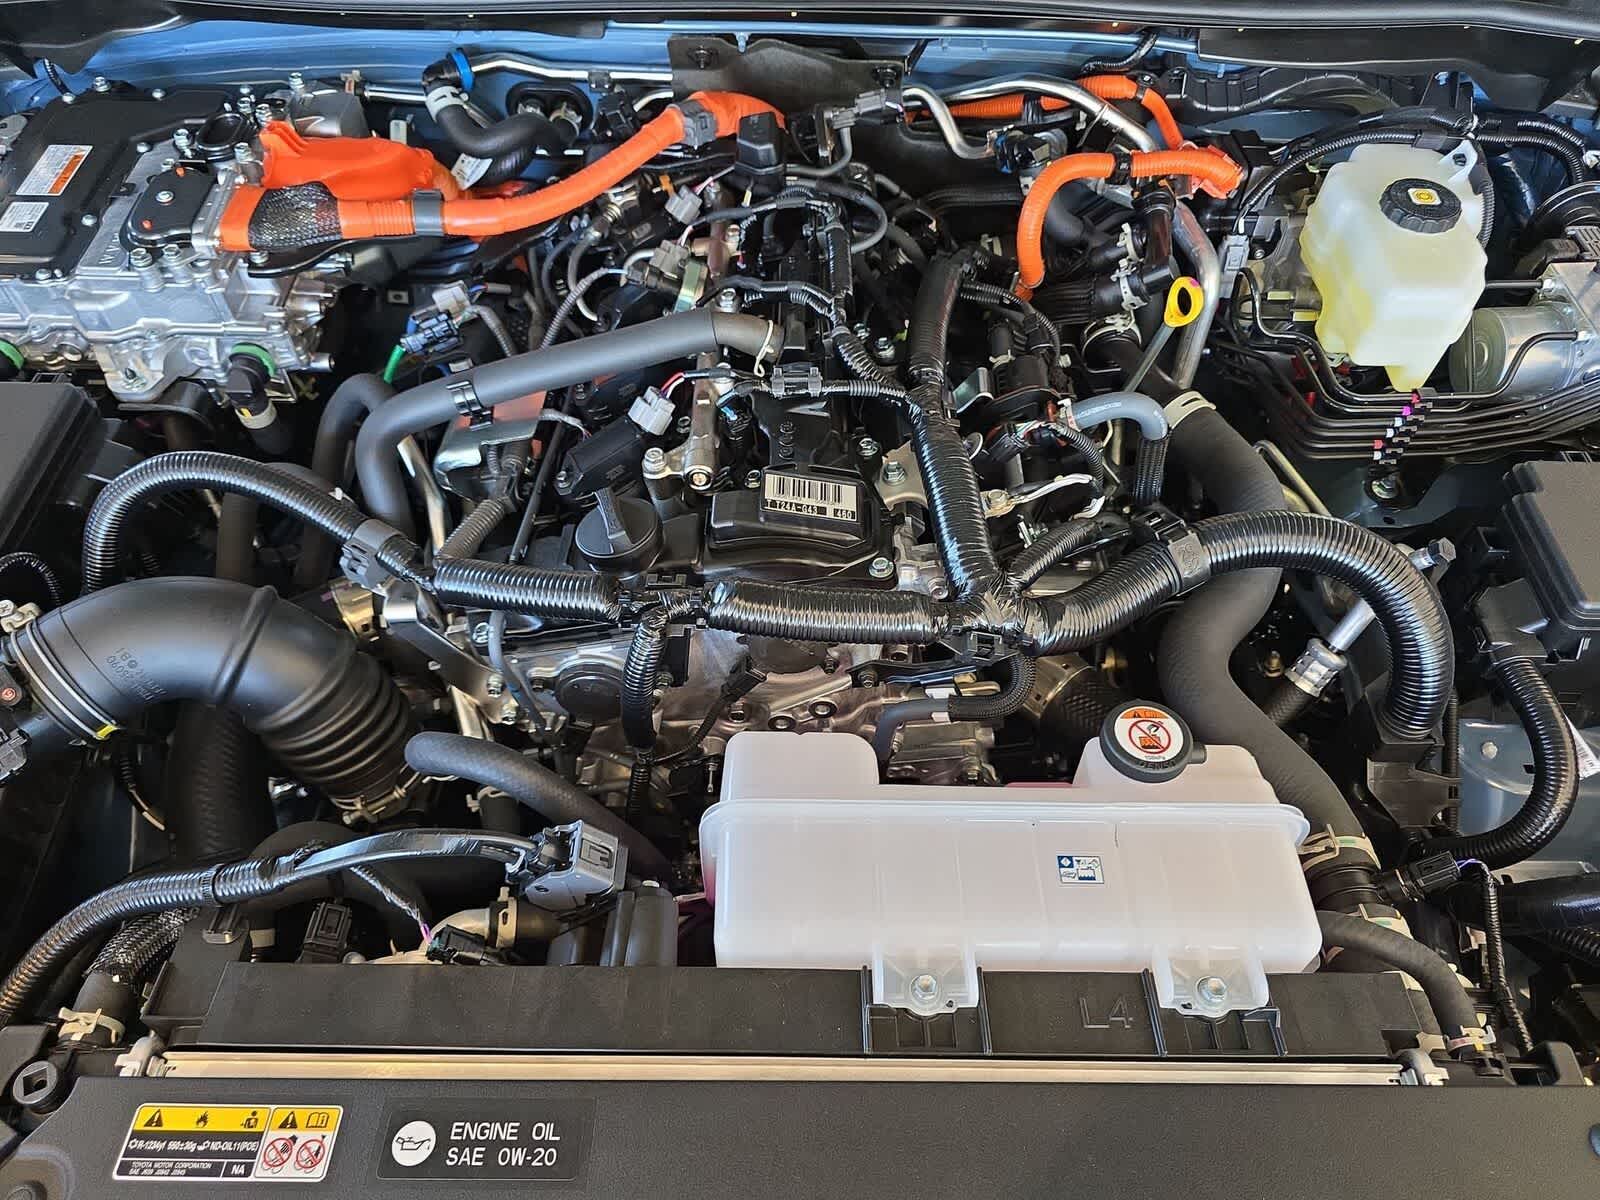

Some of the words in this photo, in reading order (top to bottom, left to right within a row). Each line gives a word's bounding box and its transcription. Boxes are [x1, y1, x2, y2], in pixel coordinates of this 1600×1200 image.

[1080, 996, 1133, 1029] L4
[450, 1121, 520, 1140] ENGINE
[532, 1122, 561, 1141] OIL
[445, 1147, 486, 1166] SAE
[498, 1147, 557, 1166] 0W-20
[231, 1164, 245, 1175] NA
